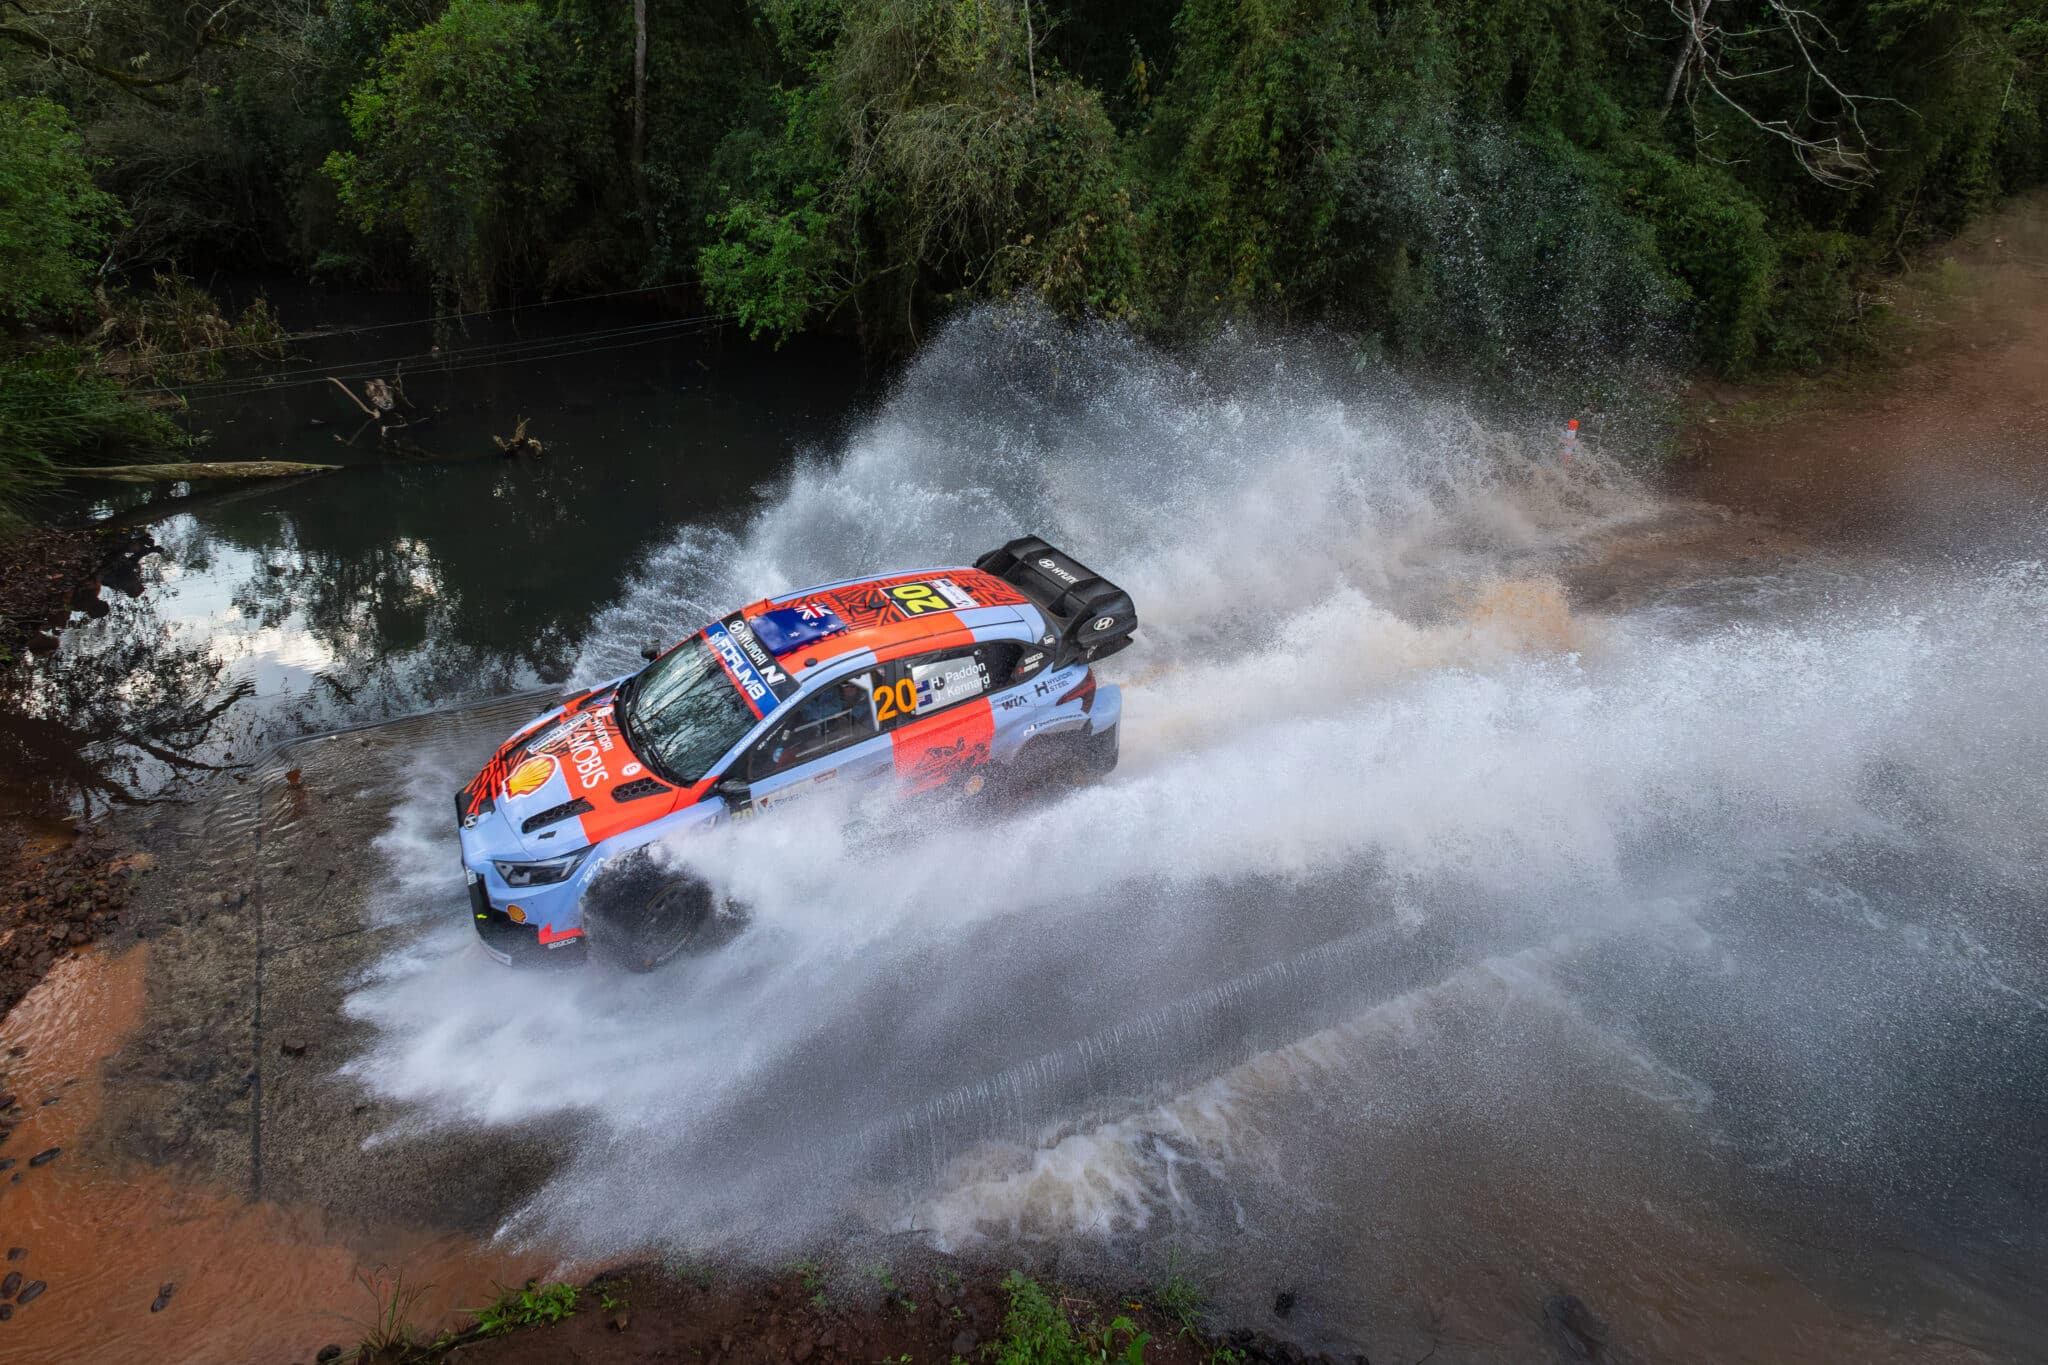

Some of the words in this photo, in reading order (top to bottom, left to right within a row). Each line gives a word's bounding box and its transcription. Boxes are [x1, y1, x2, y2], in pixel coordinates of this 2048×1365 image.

[892, 584, 949, 614] 20
[737, 631, 768, 667] HYUNDAI
[717, 633, 766, 701] FORUM8
[930, 676, 944, 689] H.
[945, 662, 986, 684] Paddon
[872, 677, 917, 722] 20
[947, 673, 991, 698] Kennard
[1049, 680, 1070, 692] STEEL
[567, 732, 609, 789] MOBIS
